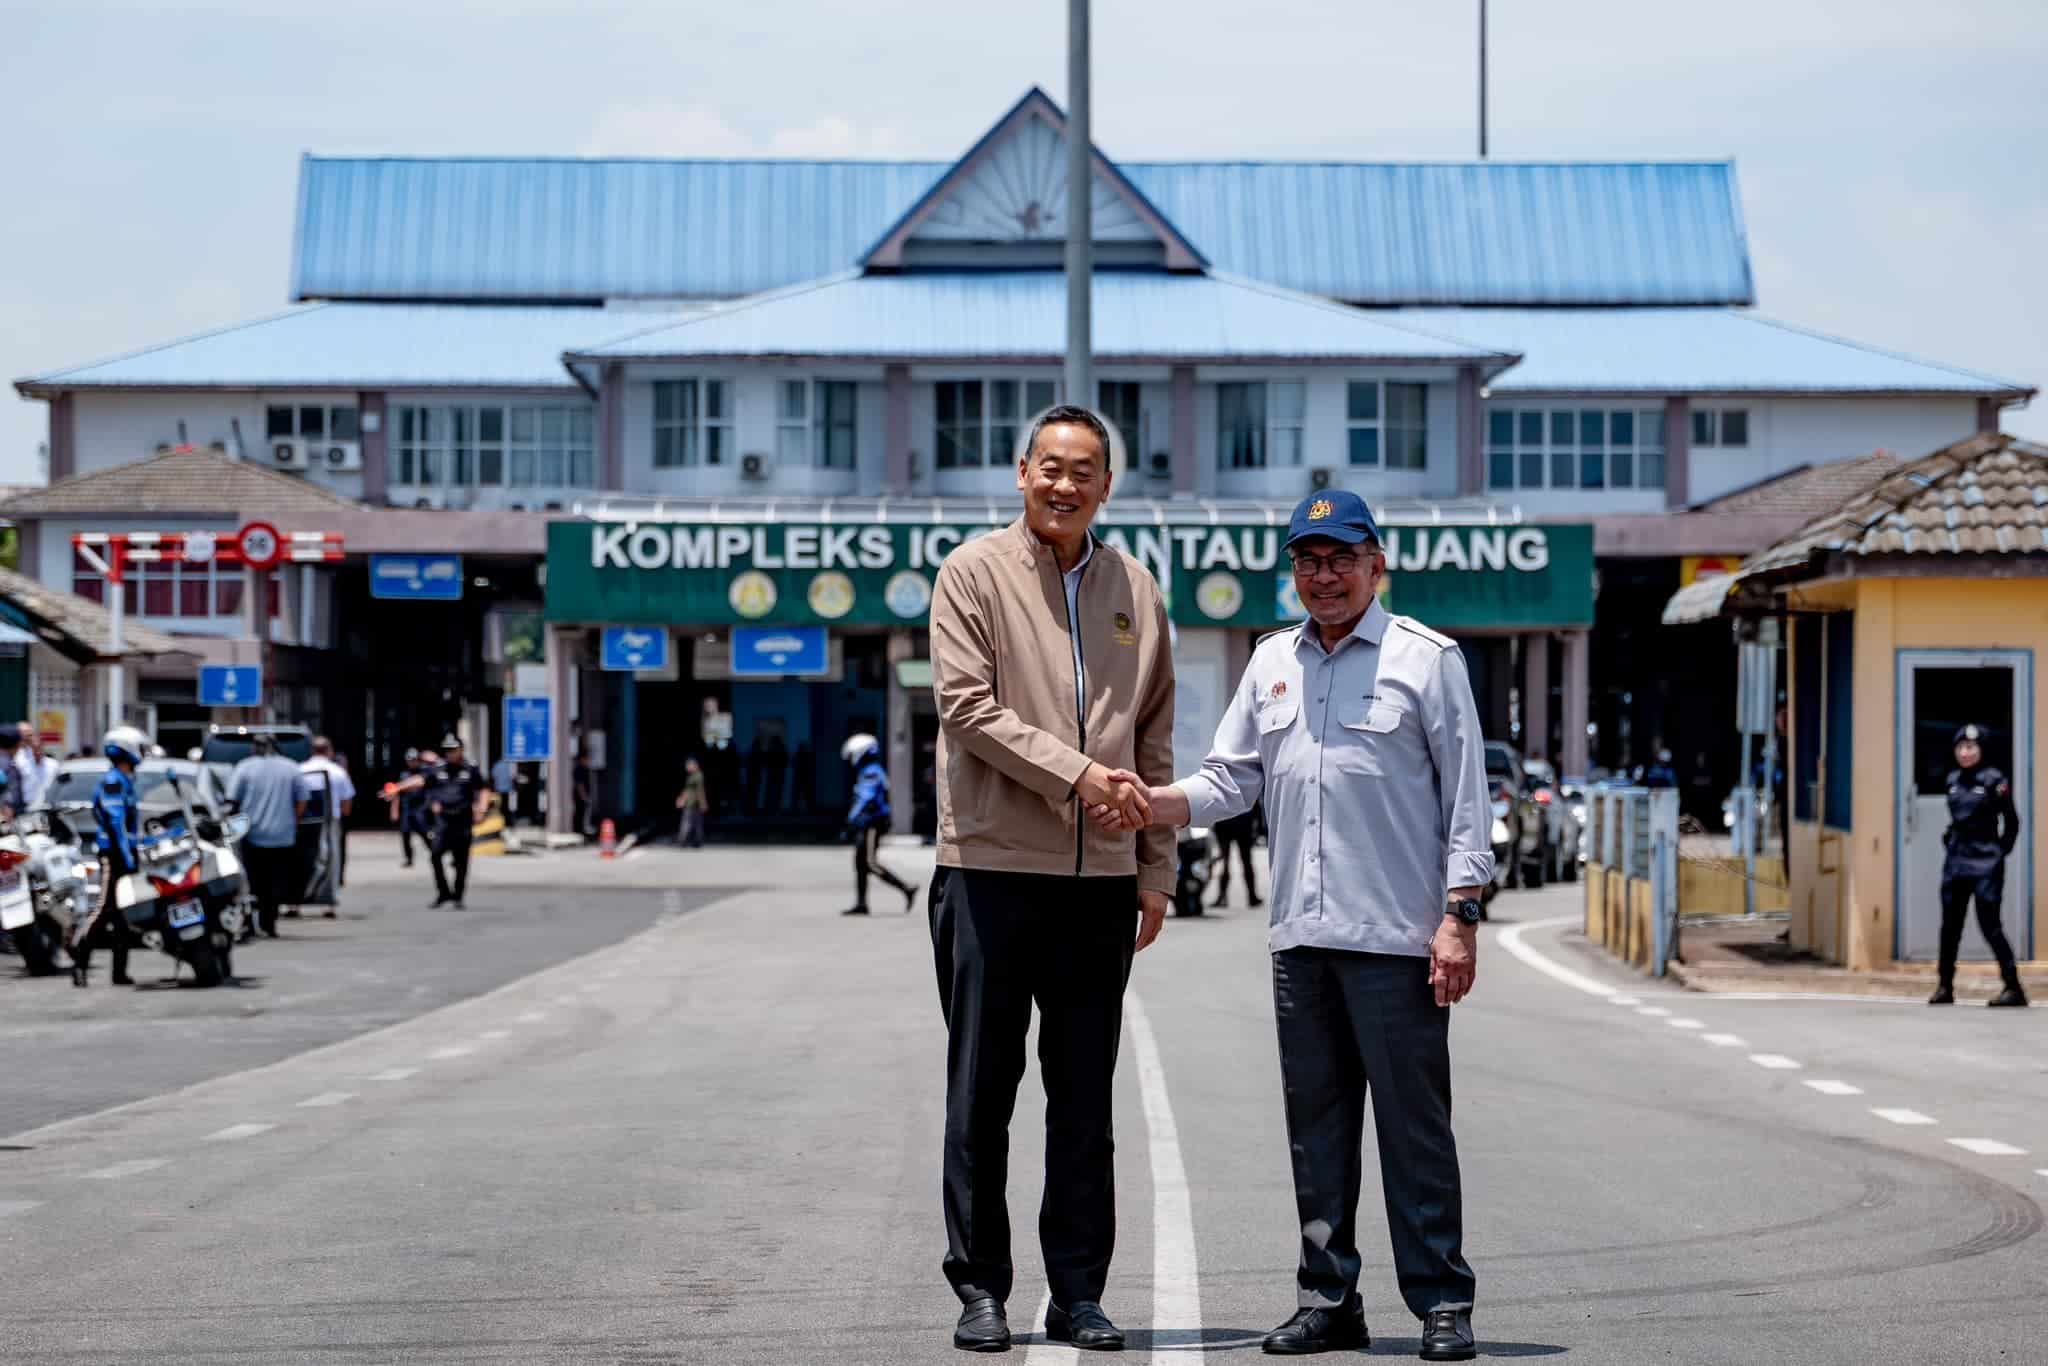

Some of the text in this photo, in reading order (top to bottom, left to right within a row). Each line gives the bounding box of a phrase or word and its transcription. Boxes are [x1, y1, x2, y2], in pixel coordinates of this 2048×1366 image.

[591, 527, 1549, 571] KOMPLEKS IC ANTAU NJANG
